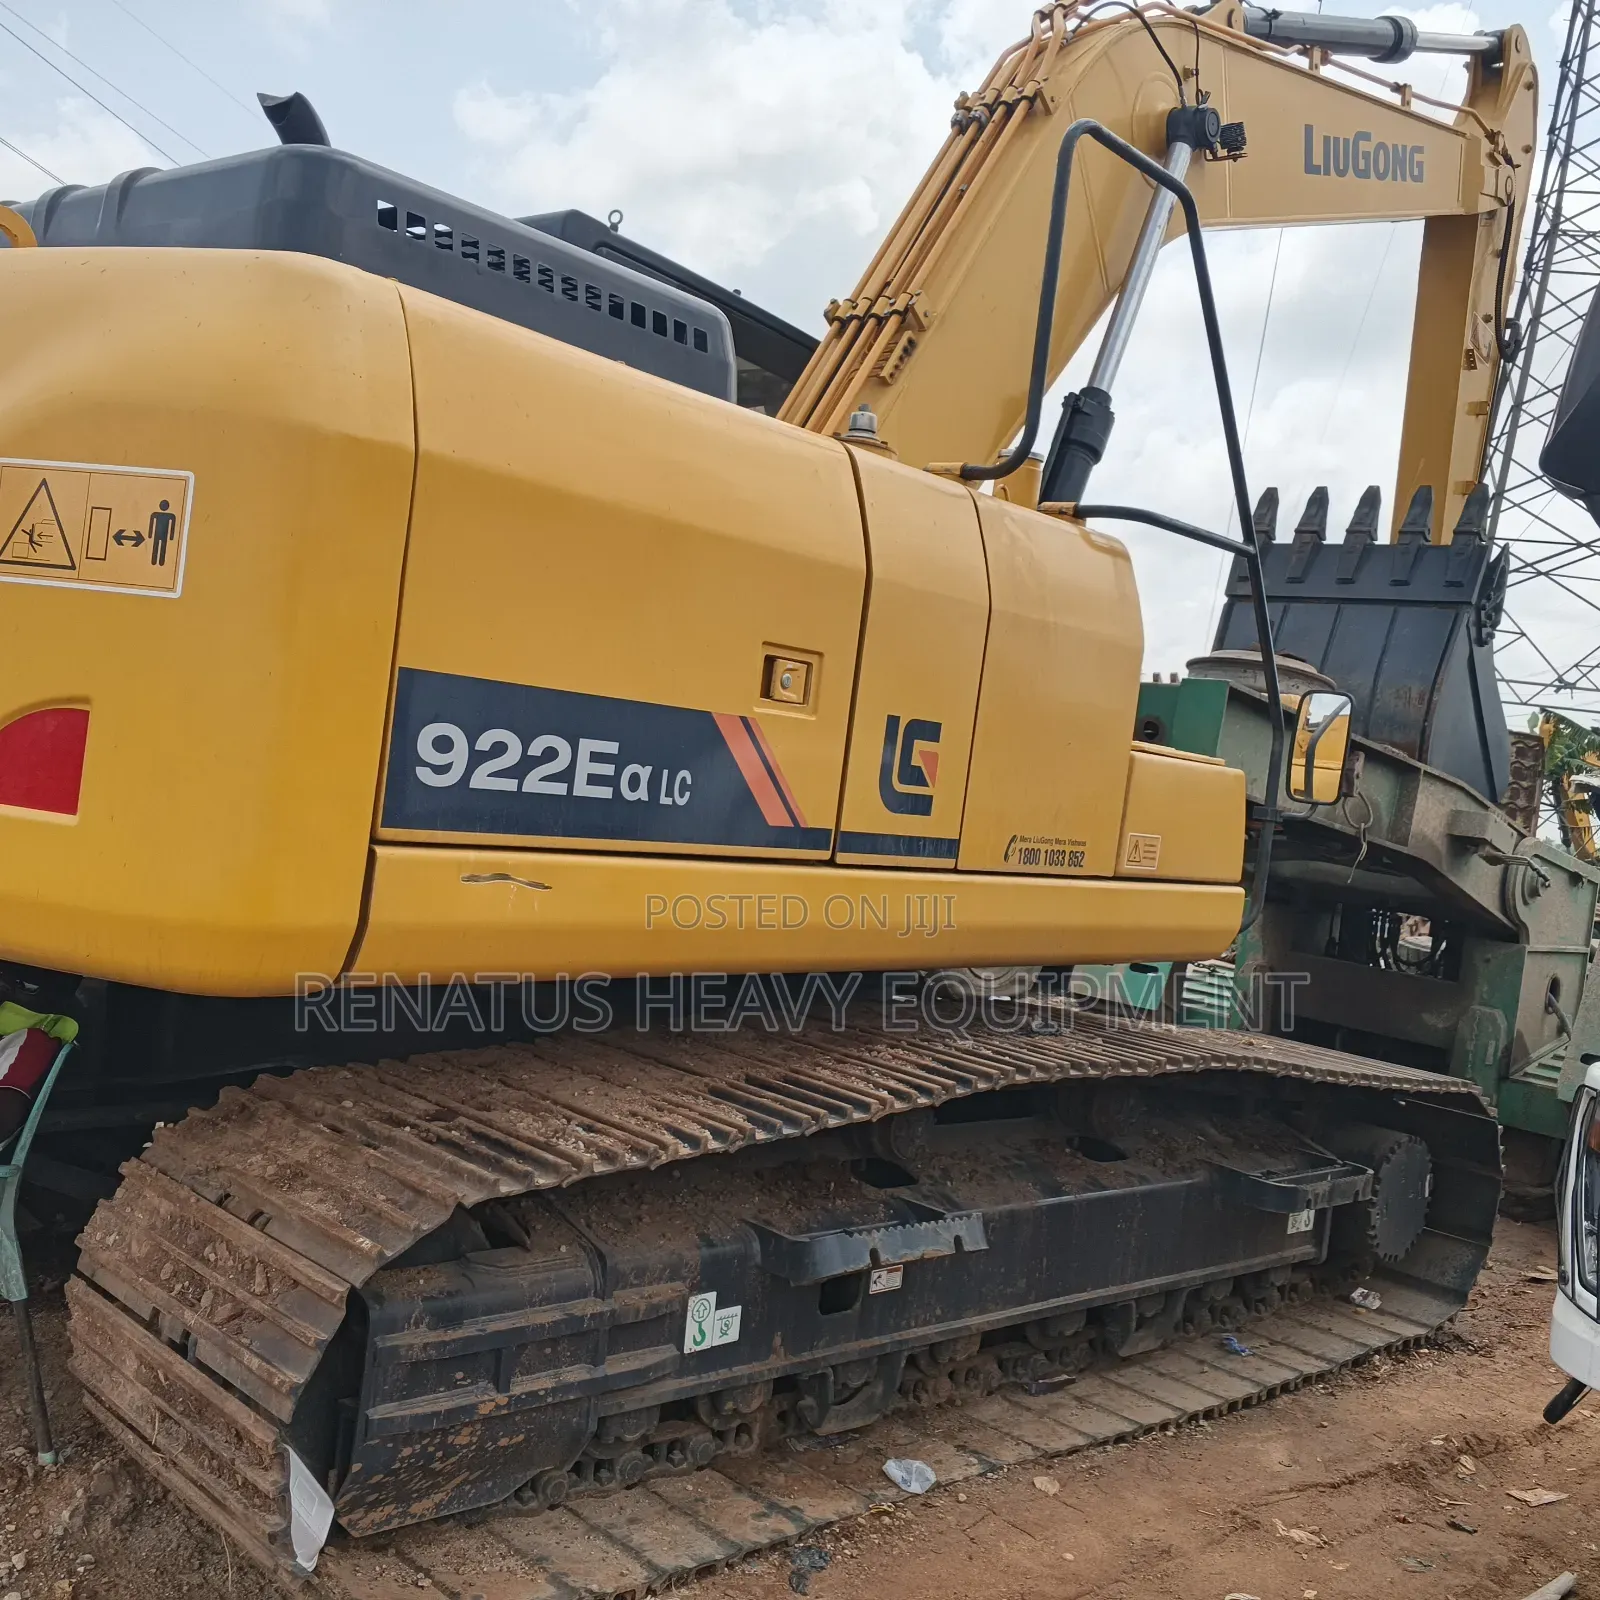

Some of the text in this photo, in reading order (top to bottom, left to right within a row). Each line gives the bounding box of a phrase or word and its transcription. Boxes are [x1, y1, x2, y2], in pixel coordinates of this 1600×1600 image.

[1033, 836, 1054, 846] LiuGong
[1018, 847, 1085, 868] 1800 1033 852
